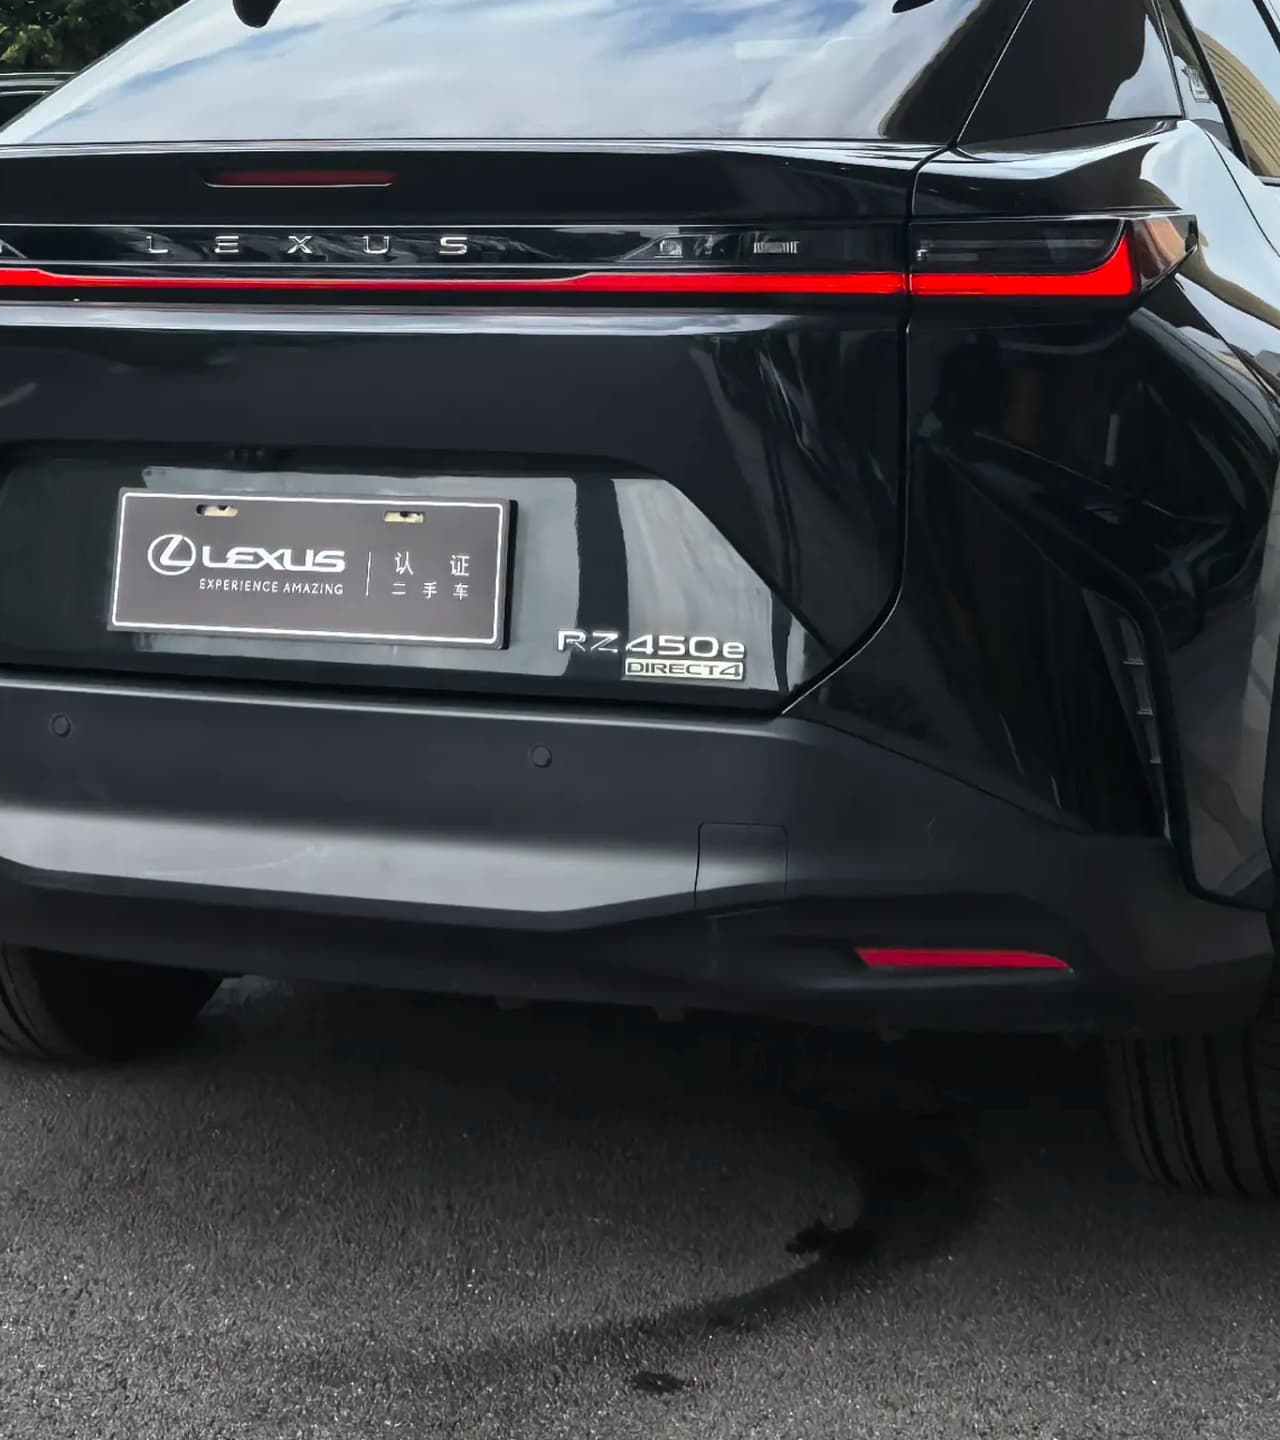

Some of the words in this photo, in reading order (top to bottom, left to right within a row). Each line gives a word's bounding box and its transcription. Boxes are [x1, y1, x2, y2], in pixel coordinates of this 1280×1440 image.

[146, 235, 467, 255] LEXUS
[202, 545, 346, 573] LEXUS
[394, 551, 470, 577] 认证
[199, 578, 279, 593] EXPERIENCE
[282, 581, 344, 596] AMAZING
[391, 581, 469, 601] 二手车
